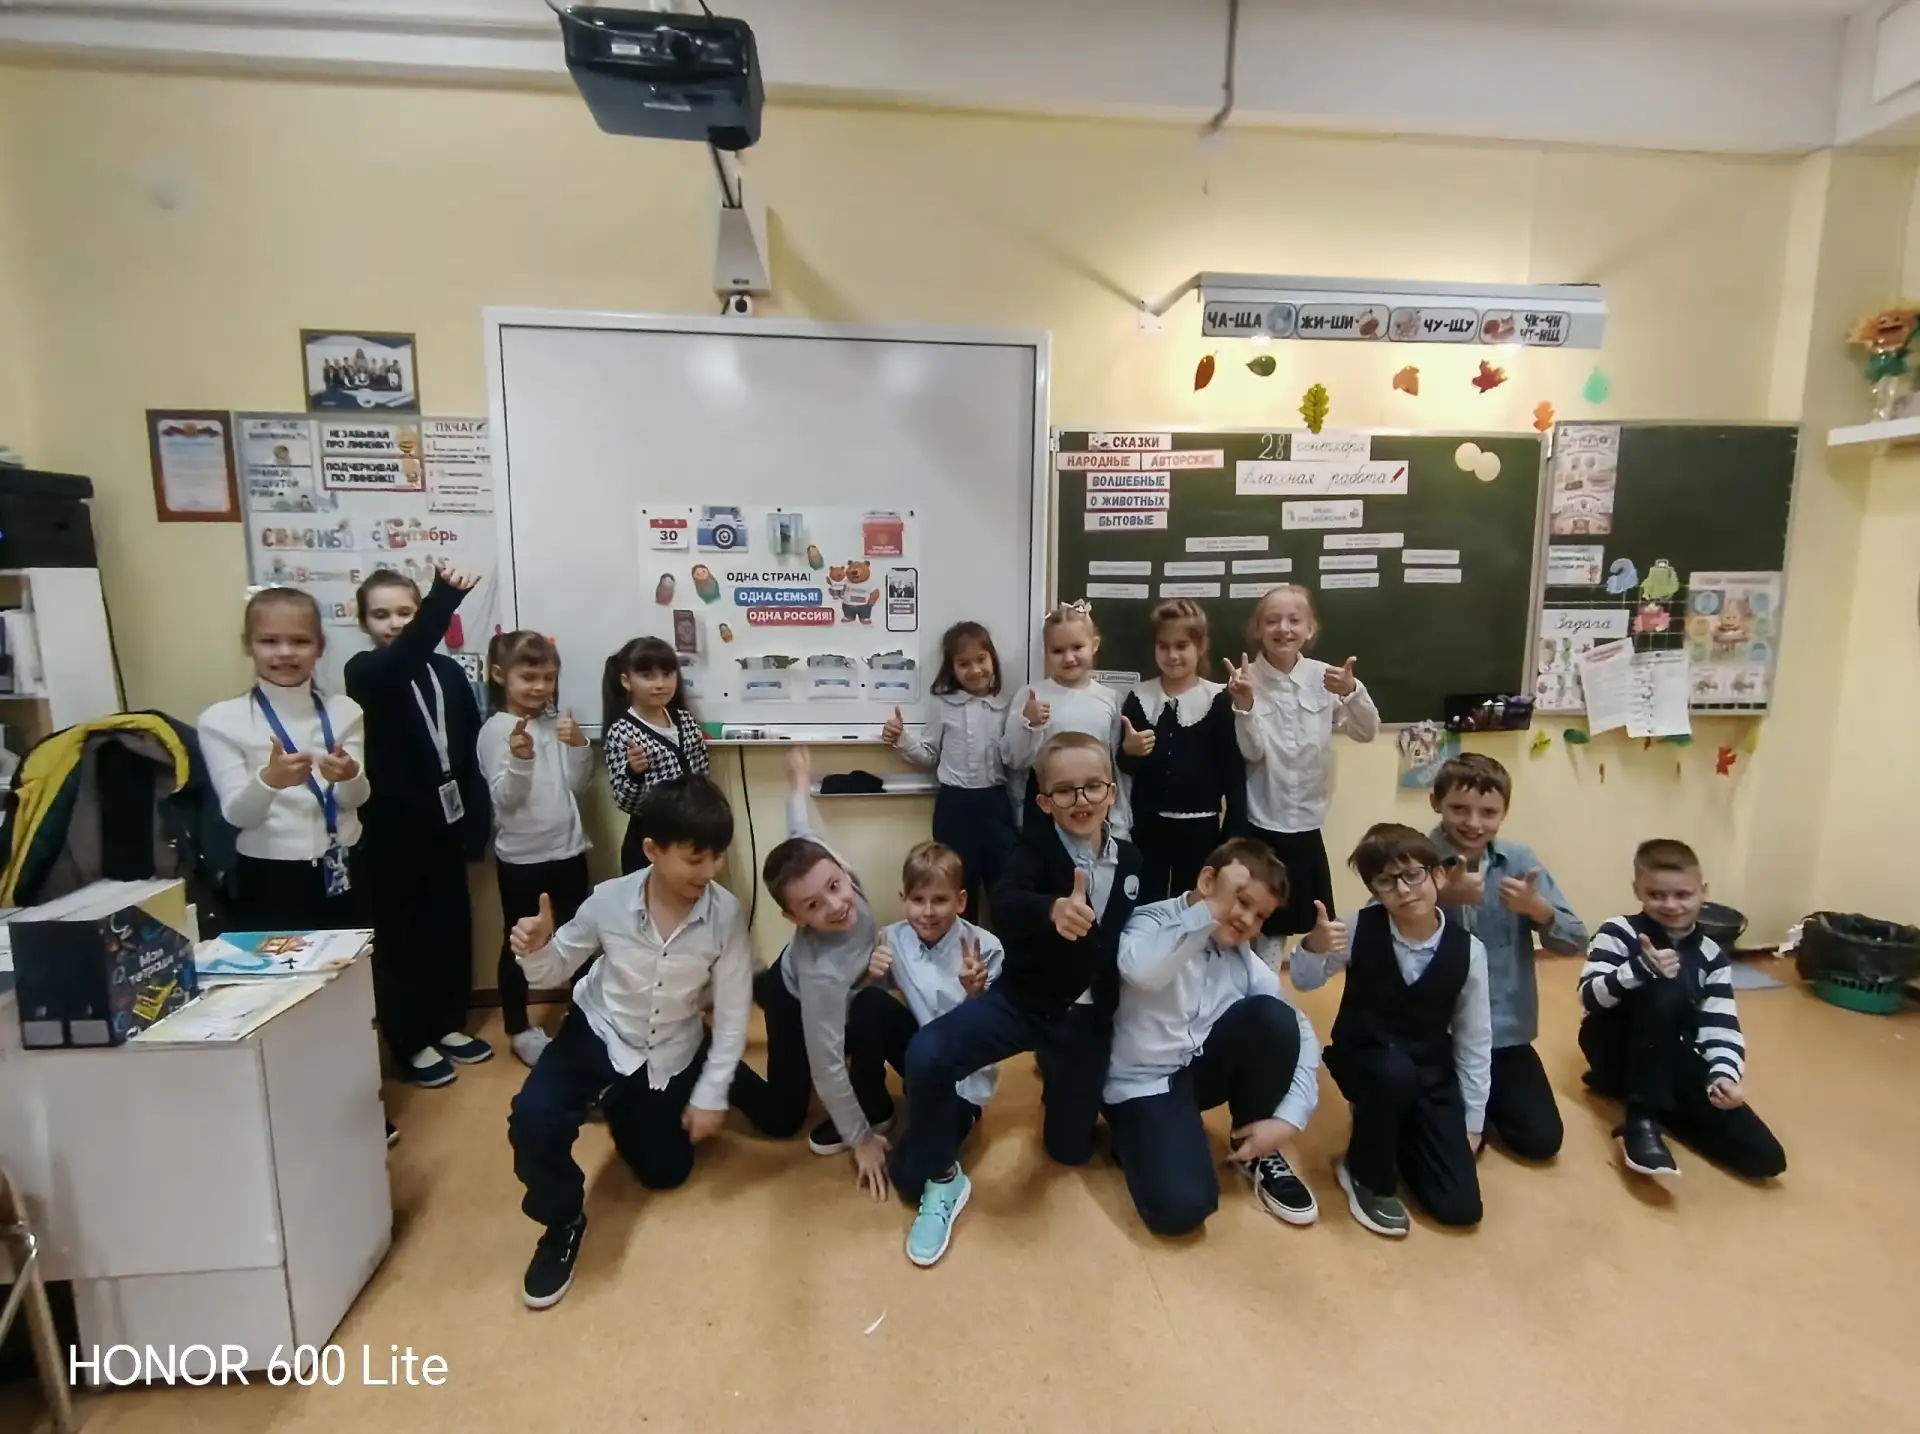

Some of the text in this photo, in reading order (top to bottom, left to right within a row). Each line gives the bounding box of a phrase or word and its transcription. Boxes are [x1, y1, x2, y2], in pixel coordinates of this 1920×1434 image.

[1207, 311, 1262, 328] ЧА-ЩА
[1301, 316, 1354, 329] ЖИ-ШИ
[1424, 318, 1475, 333] ЧУ-ЩУ
[1112, 436, 1160, 448] СКАЗКИ
[1258, 433, 1285, 460] 28
[1067, 455, 1131, 468] НАРОДНЫЕ
[1150, 453, 1216, 467] АВТОРСКИЕ
[1092, 474, 1165, 487] ВОЛШЕБНЫЕ
[1326, 464, 1387, 492] работа
[1090, 494, 1165, 507] О ЖИВОТНЫХ
[1098, 514, 1154, 527] БЫТОВЫЕ
[660, 530, 678, 541] 30
[726, 572, 811, 583] ОДНА СТРАНА!
[739, 591, 818, 603] ОДНА СЕМЬЯ!
[749, 611, 832, 623] ОДНА РОССИЯ!
